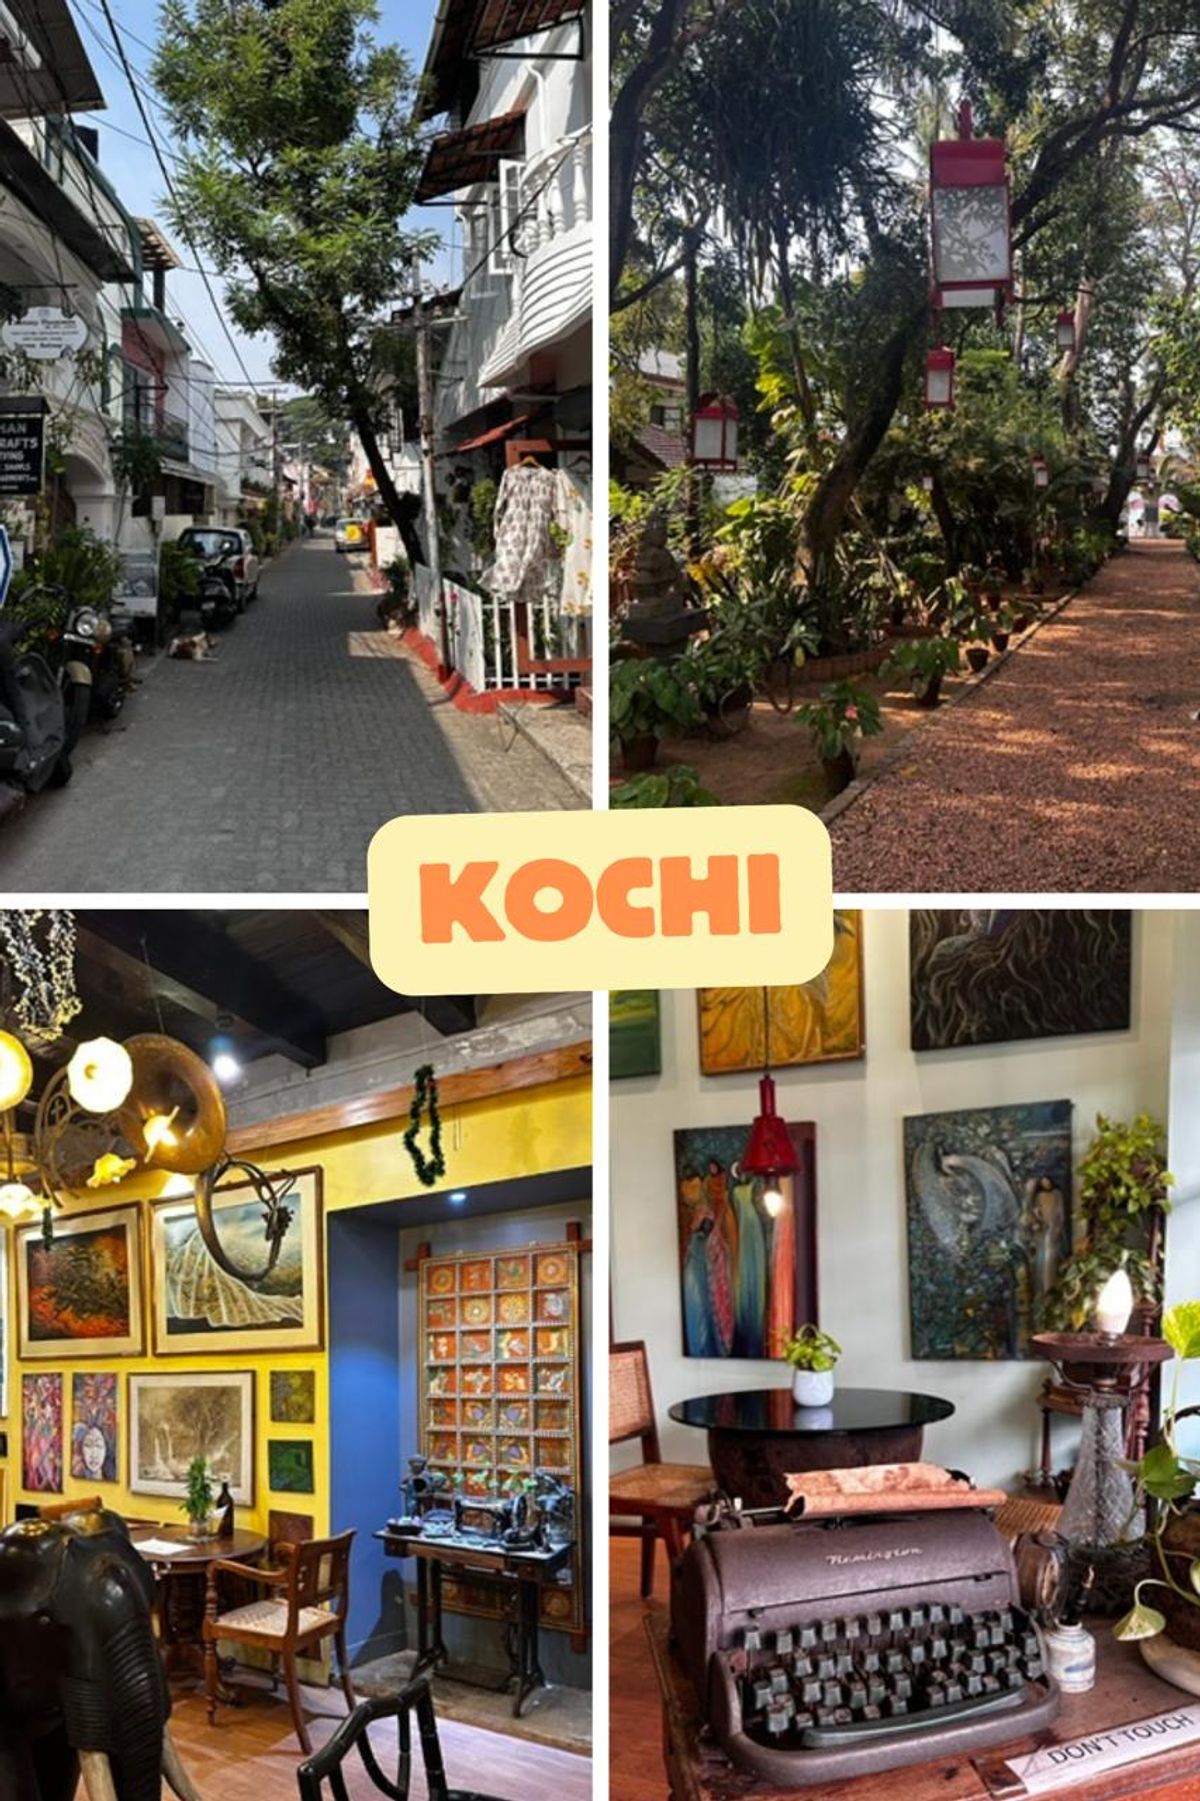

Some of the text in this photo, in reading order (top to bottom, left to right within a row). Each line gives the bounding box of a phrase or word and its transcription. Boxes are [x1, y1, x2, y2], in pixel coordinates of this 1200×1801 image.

[825, 1548, 924, 1565] Remington
[1048, 1713, 1195, 1764] DON'T TOUCH
